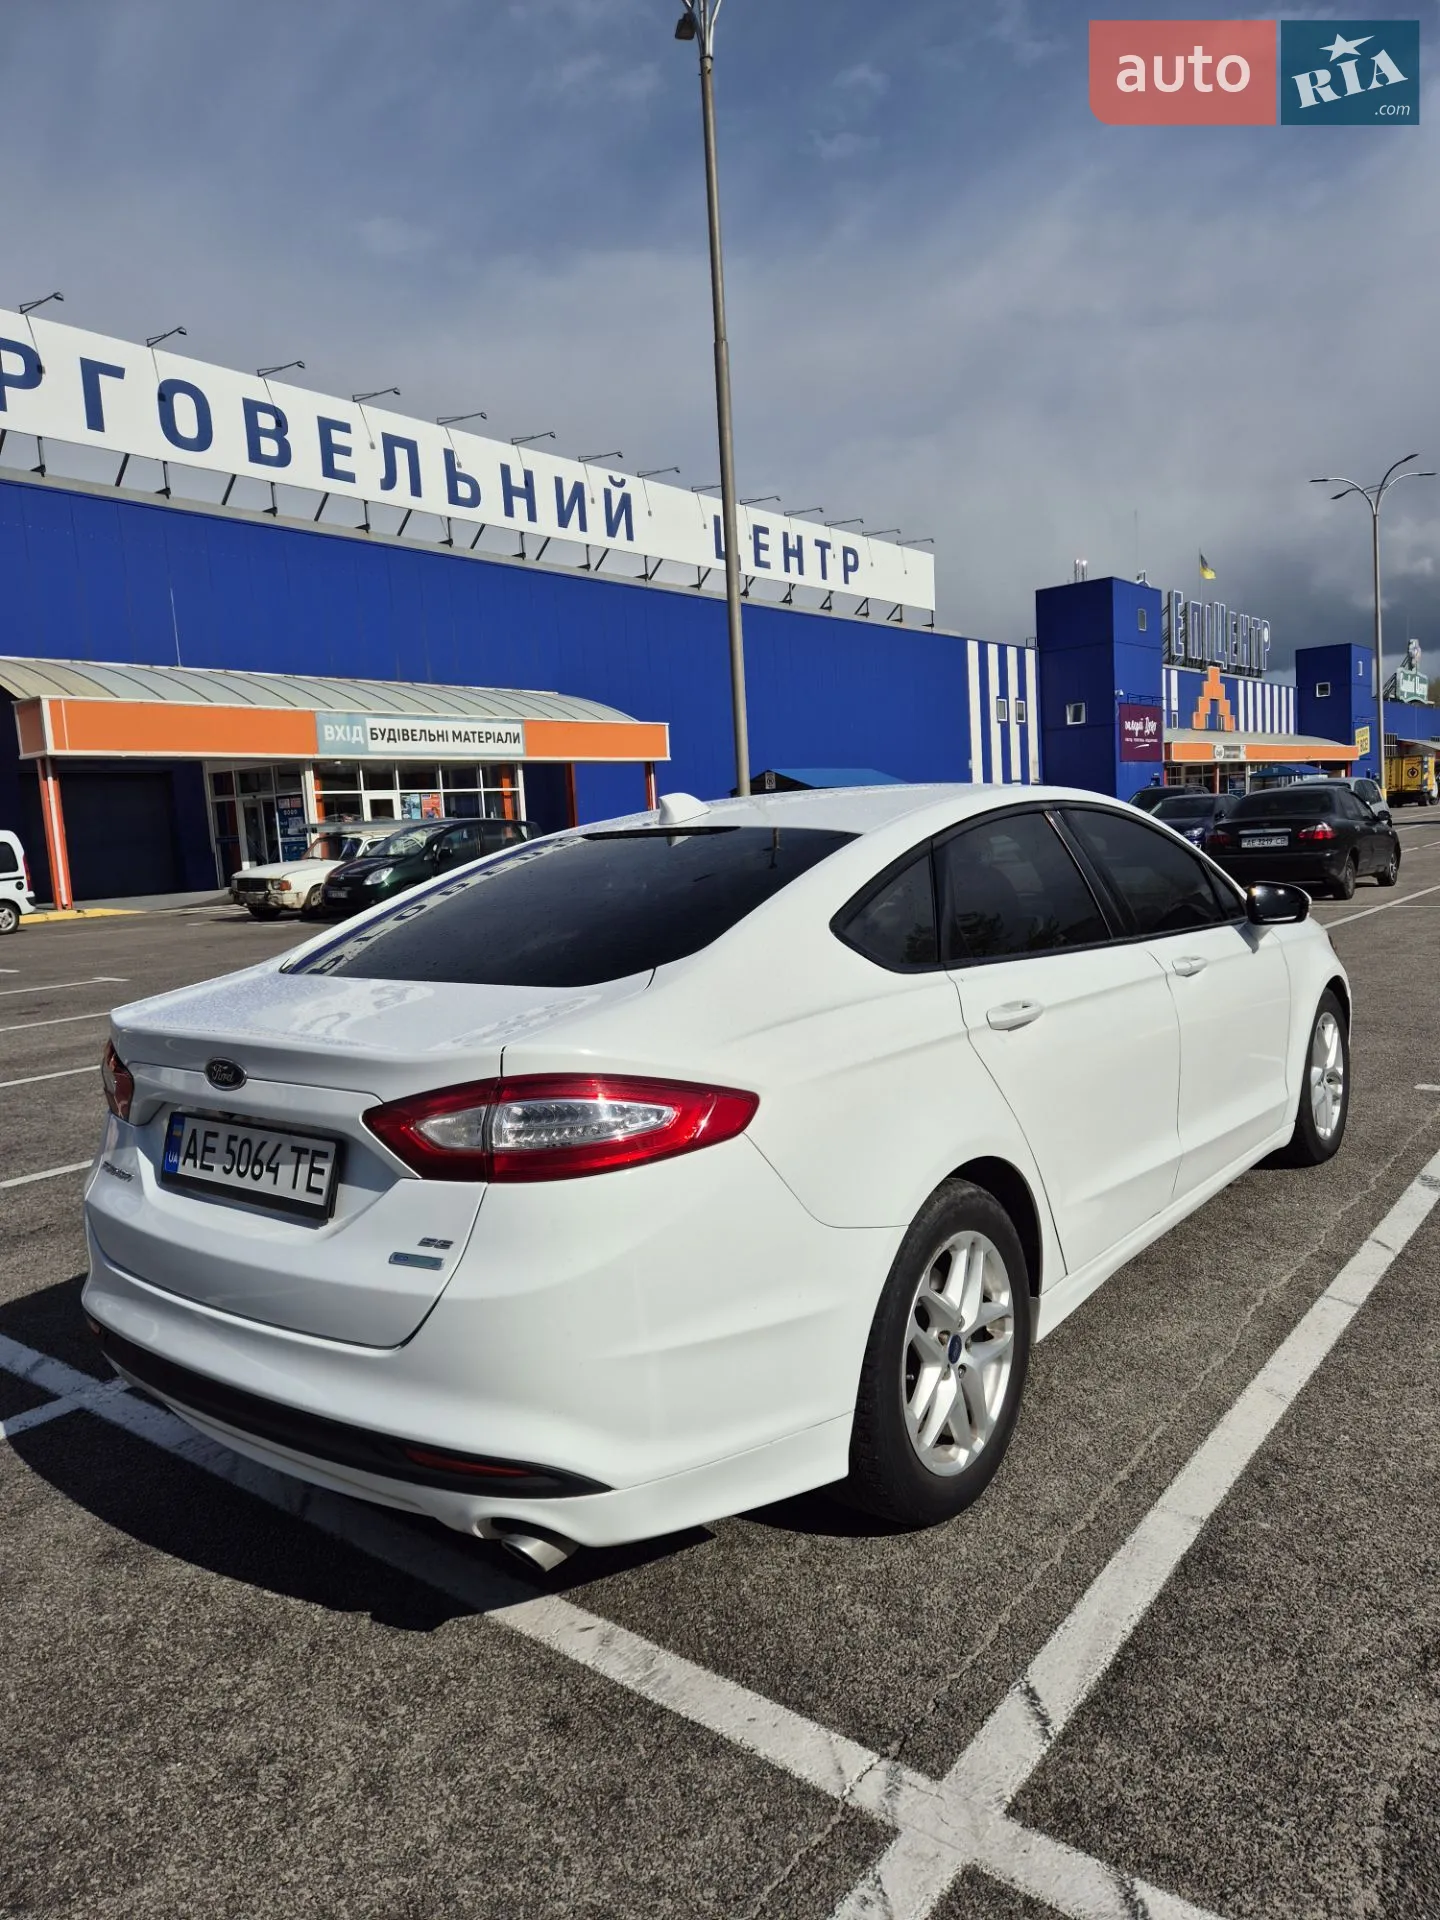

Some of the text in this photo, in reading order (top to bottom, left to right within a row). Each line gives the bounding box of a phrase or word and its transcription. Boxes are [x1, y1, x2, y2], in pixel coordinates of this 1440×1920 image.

[323, 725, 521, 745] ВХІД БУДІВЕЛЬНІ МАТЕРІАЛИ
[168, 1151, 178, 1164] UA
[182, 1128, 219, 1172] AE
[222, 1134, 283, 1186] 5064
[290, 1145, 329, 1195] TE
